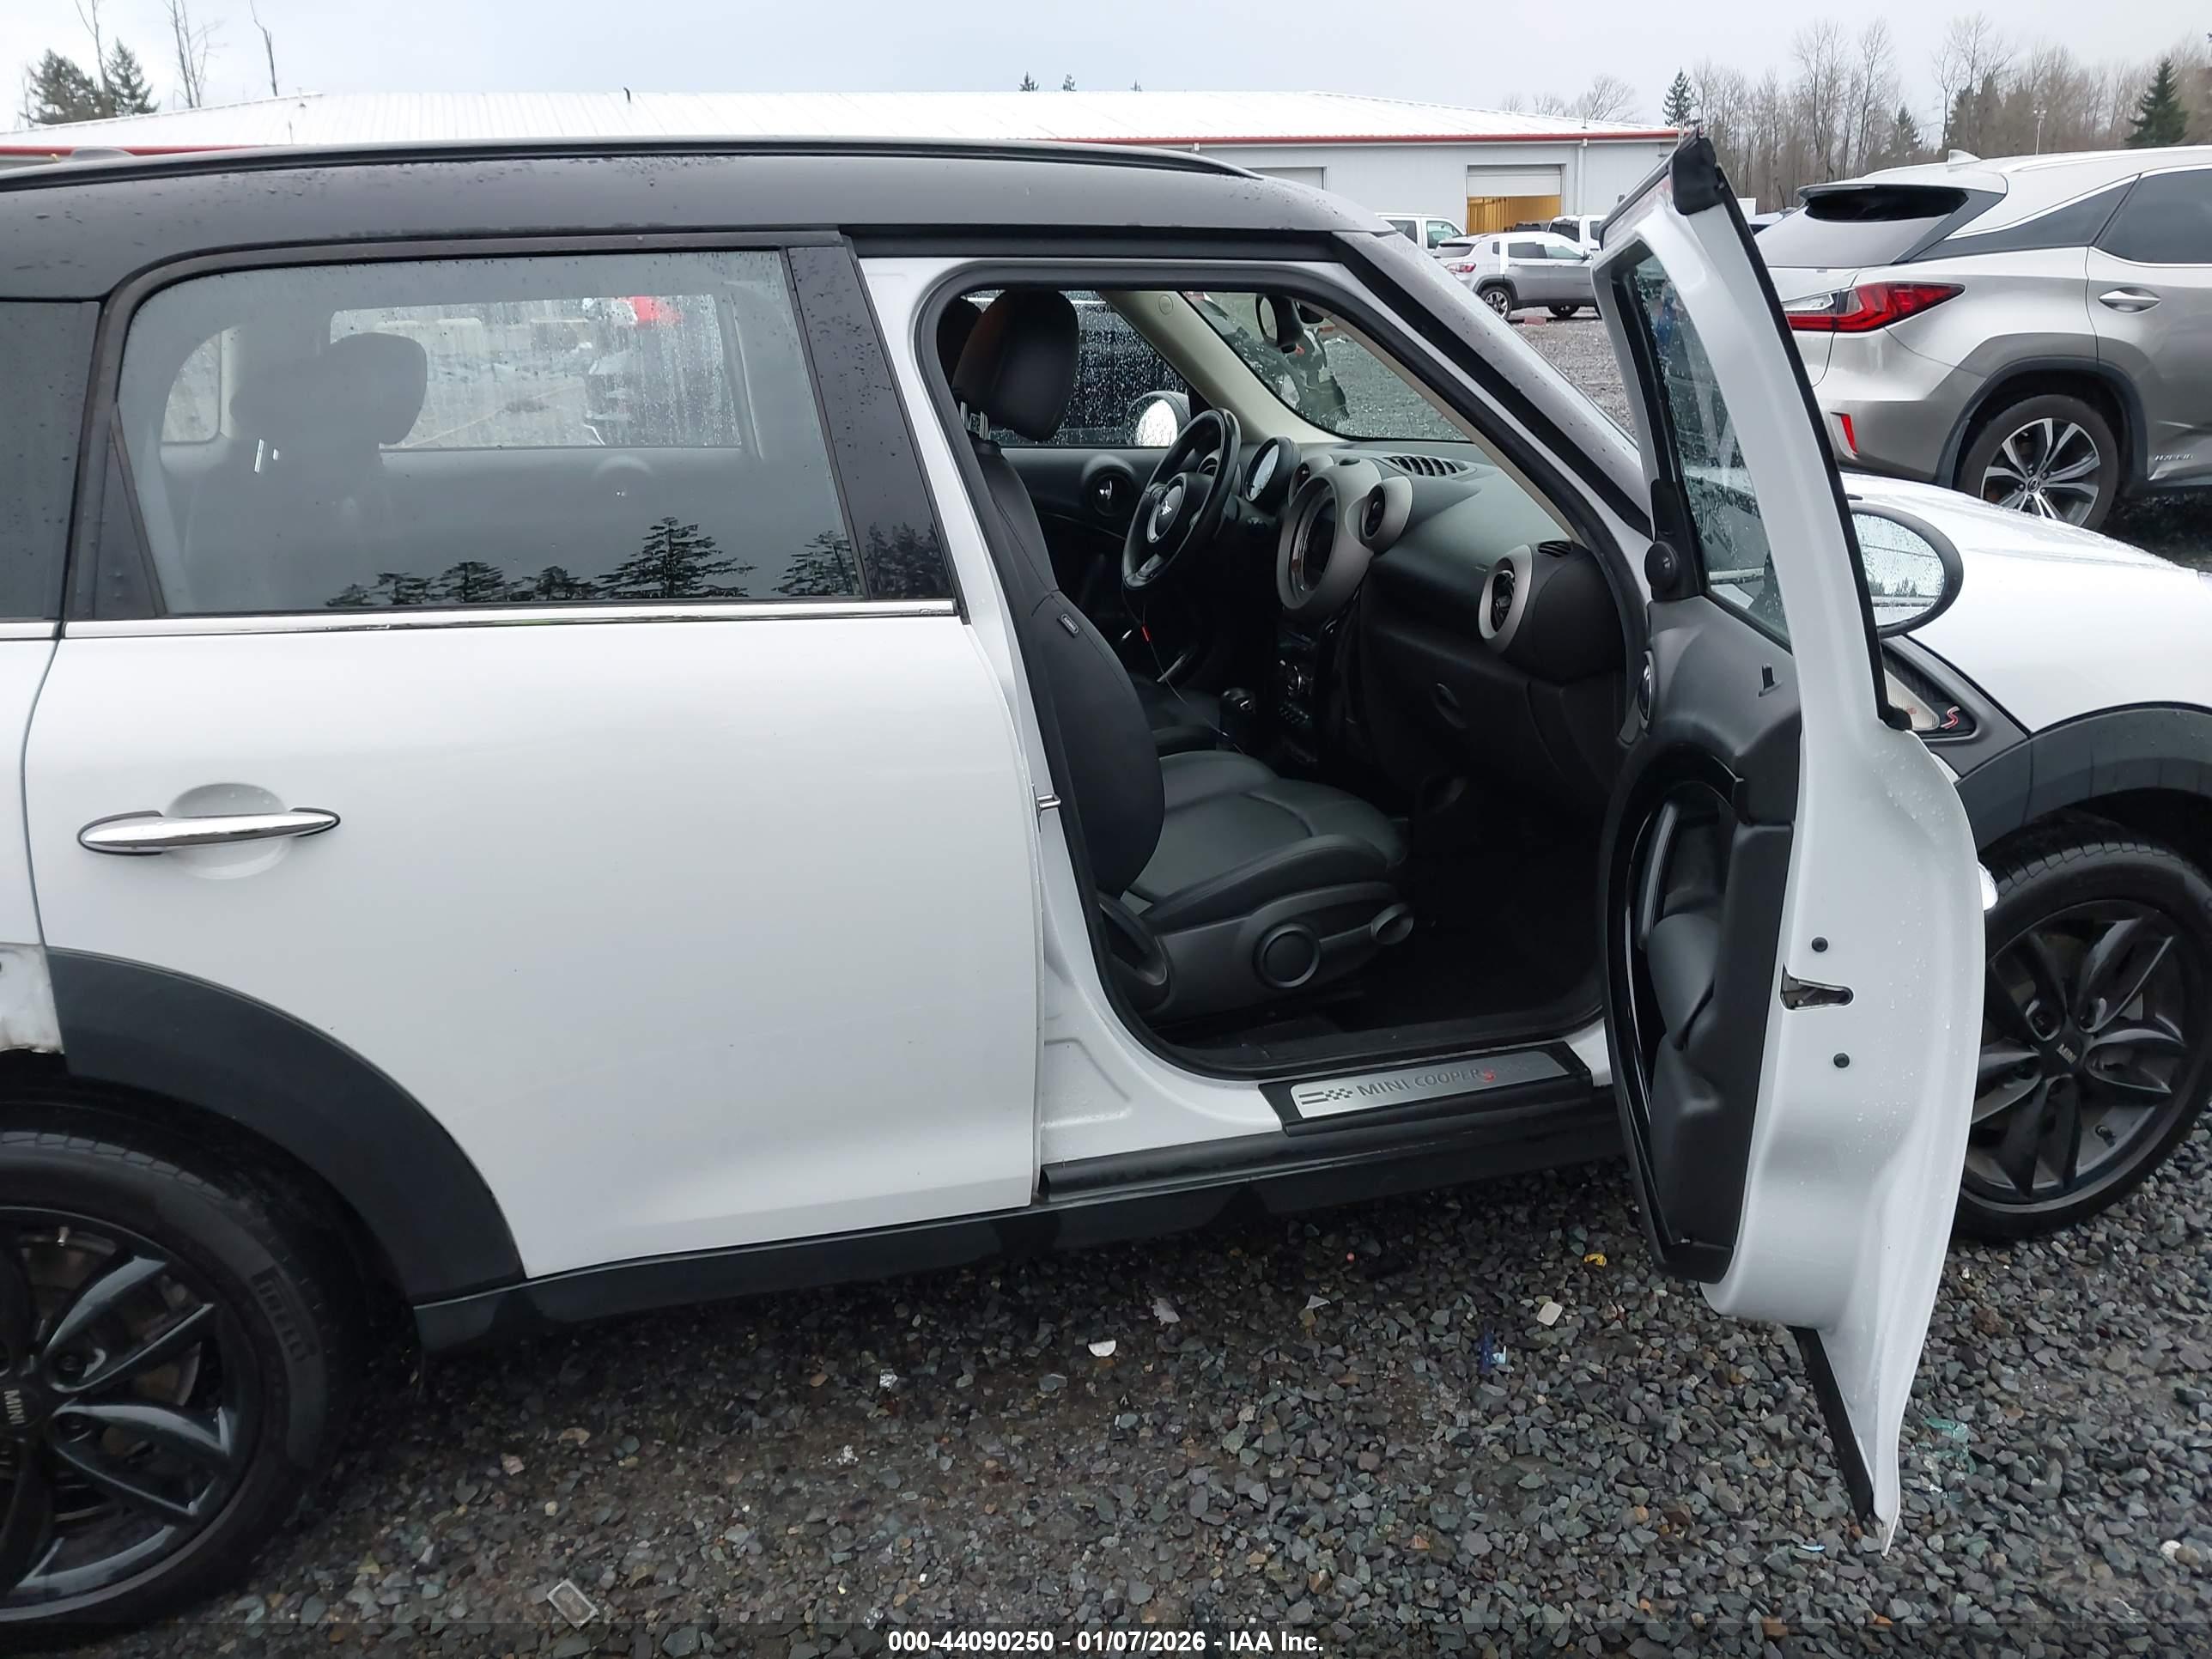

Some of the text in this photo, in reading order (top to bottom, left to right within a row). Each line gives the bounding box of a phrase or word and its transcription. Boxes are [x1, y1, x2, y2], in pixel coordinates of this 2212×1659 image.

[1356, 1066, 1496, 1097] MINI COOPER S
[3, 1389, 26, 1425] MINI
